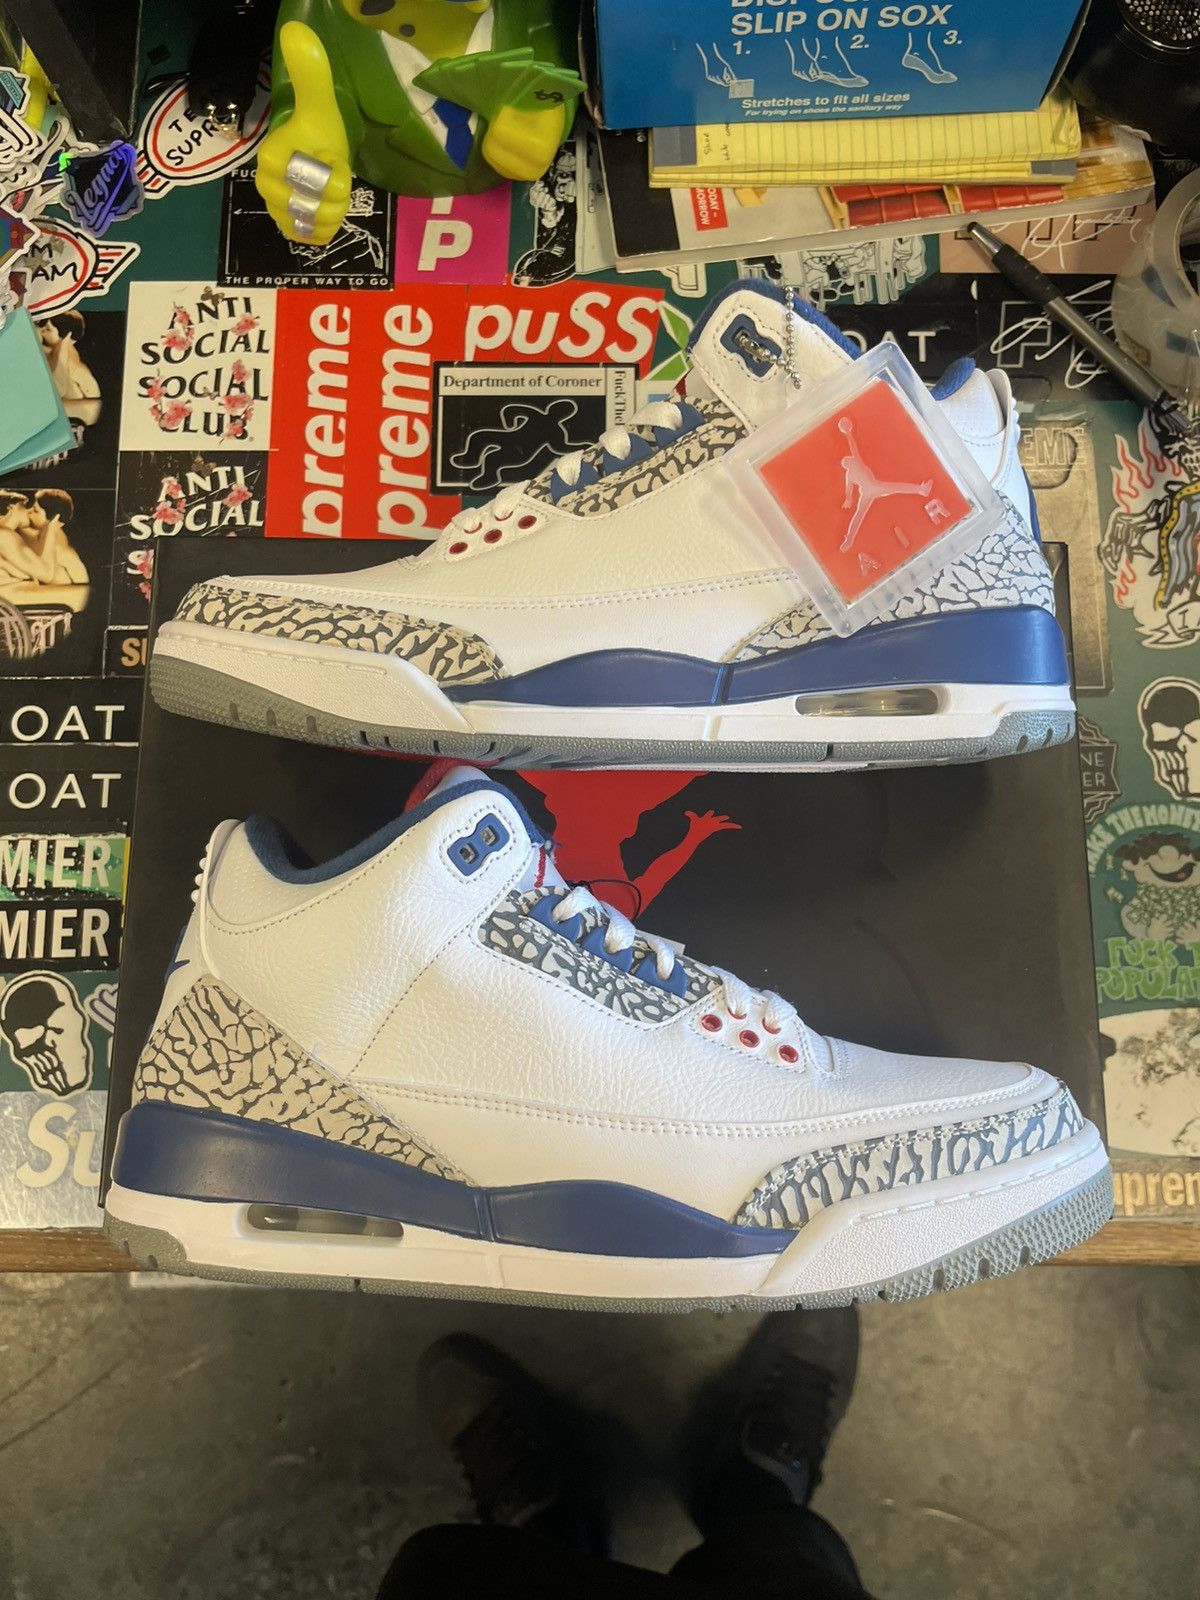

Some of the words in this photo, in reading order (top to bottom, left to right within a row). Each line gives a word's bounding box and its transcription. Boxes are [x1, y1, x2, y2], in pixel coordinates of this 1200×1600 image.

[731, 11, 807, 36] SLIP
[817, 8, 869, 31] ON
[878, 5, 952, 28] SOX
[733, 40, 751, 55] 1.
[850, 34, 869, 49] 2.
[943, 31, 962, 45] 3.
[742, 97, 811, 109] Stretches
[815, 96, 829, 106] to
[833, 95, 848, 104] fit
[851, 94, 869, 104] all
[873, 92, 911, 103] sizes
[762, 109, 788, 117] trying
[847, 105, 885, 113] sanitary
[885, 104, 904, 112] way
[226, 277, 250, 285] THE
[256, 277, 309, 285] PROPER
[370, 278, 388, 286] GO
[167, 297, 253, 329] ANTI
[464, 291, 658, 364] puSS
[140, 329, 270, 366] SOCIAL
[137, 367, 269, 402] SOCIAL
[443, 374, 525, 390] Department
[529, 374, 542, 387] of
[545, 375, 603, 388] Coroner
[614, 370, 627, 399] Fuck
[158, 408, 250, 441] CLUB
[157, 465, 247, 504] ANTI
[130, 499, 265, 540] SOCIAL
[858, 498, 951, 578] AIR
[11, 704, 125, 741] OAT
[9, 772, 122, 809] OAT
[1083, 772, 1106, 787] ER
[0, 839, 111, 889] MIER
[0, 908, 110, 959] MIER
[1107, 937, 1178, 969] FUCK
